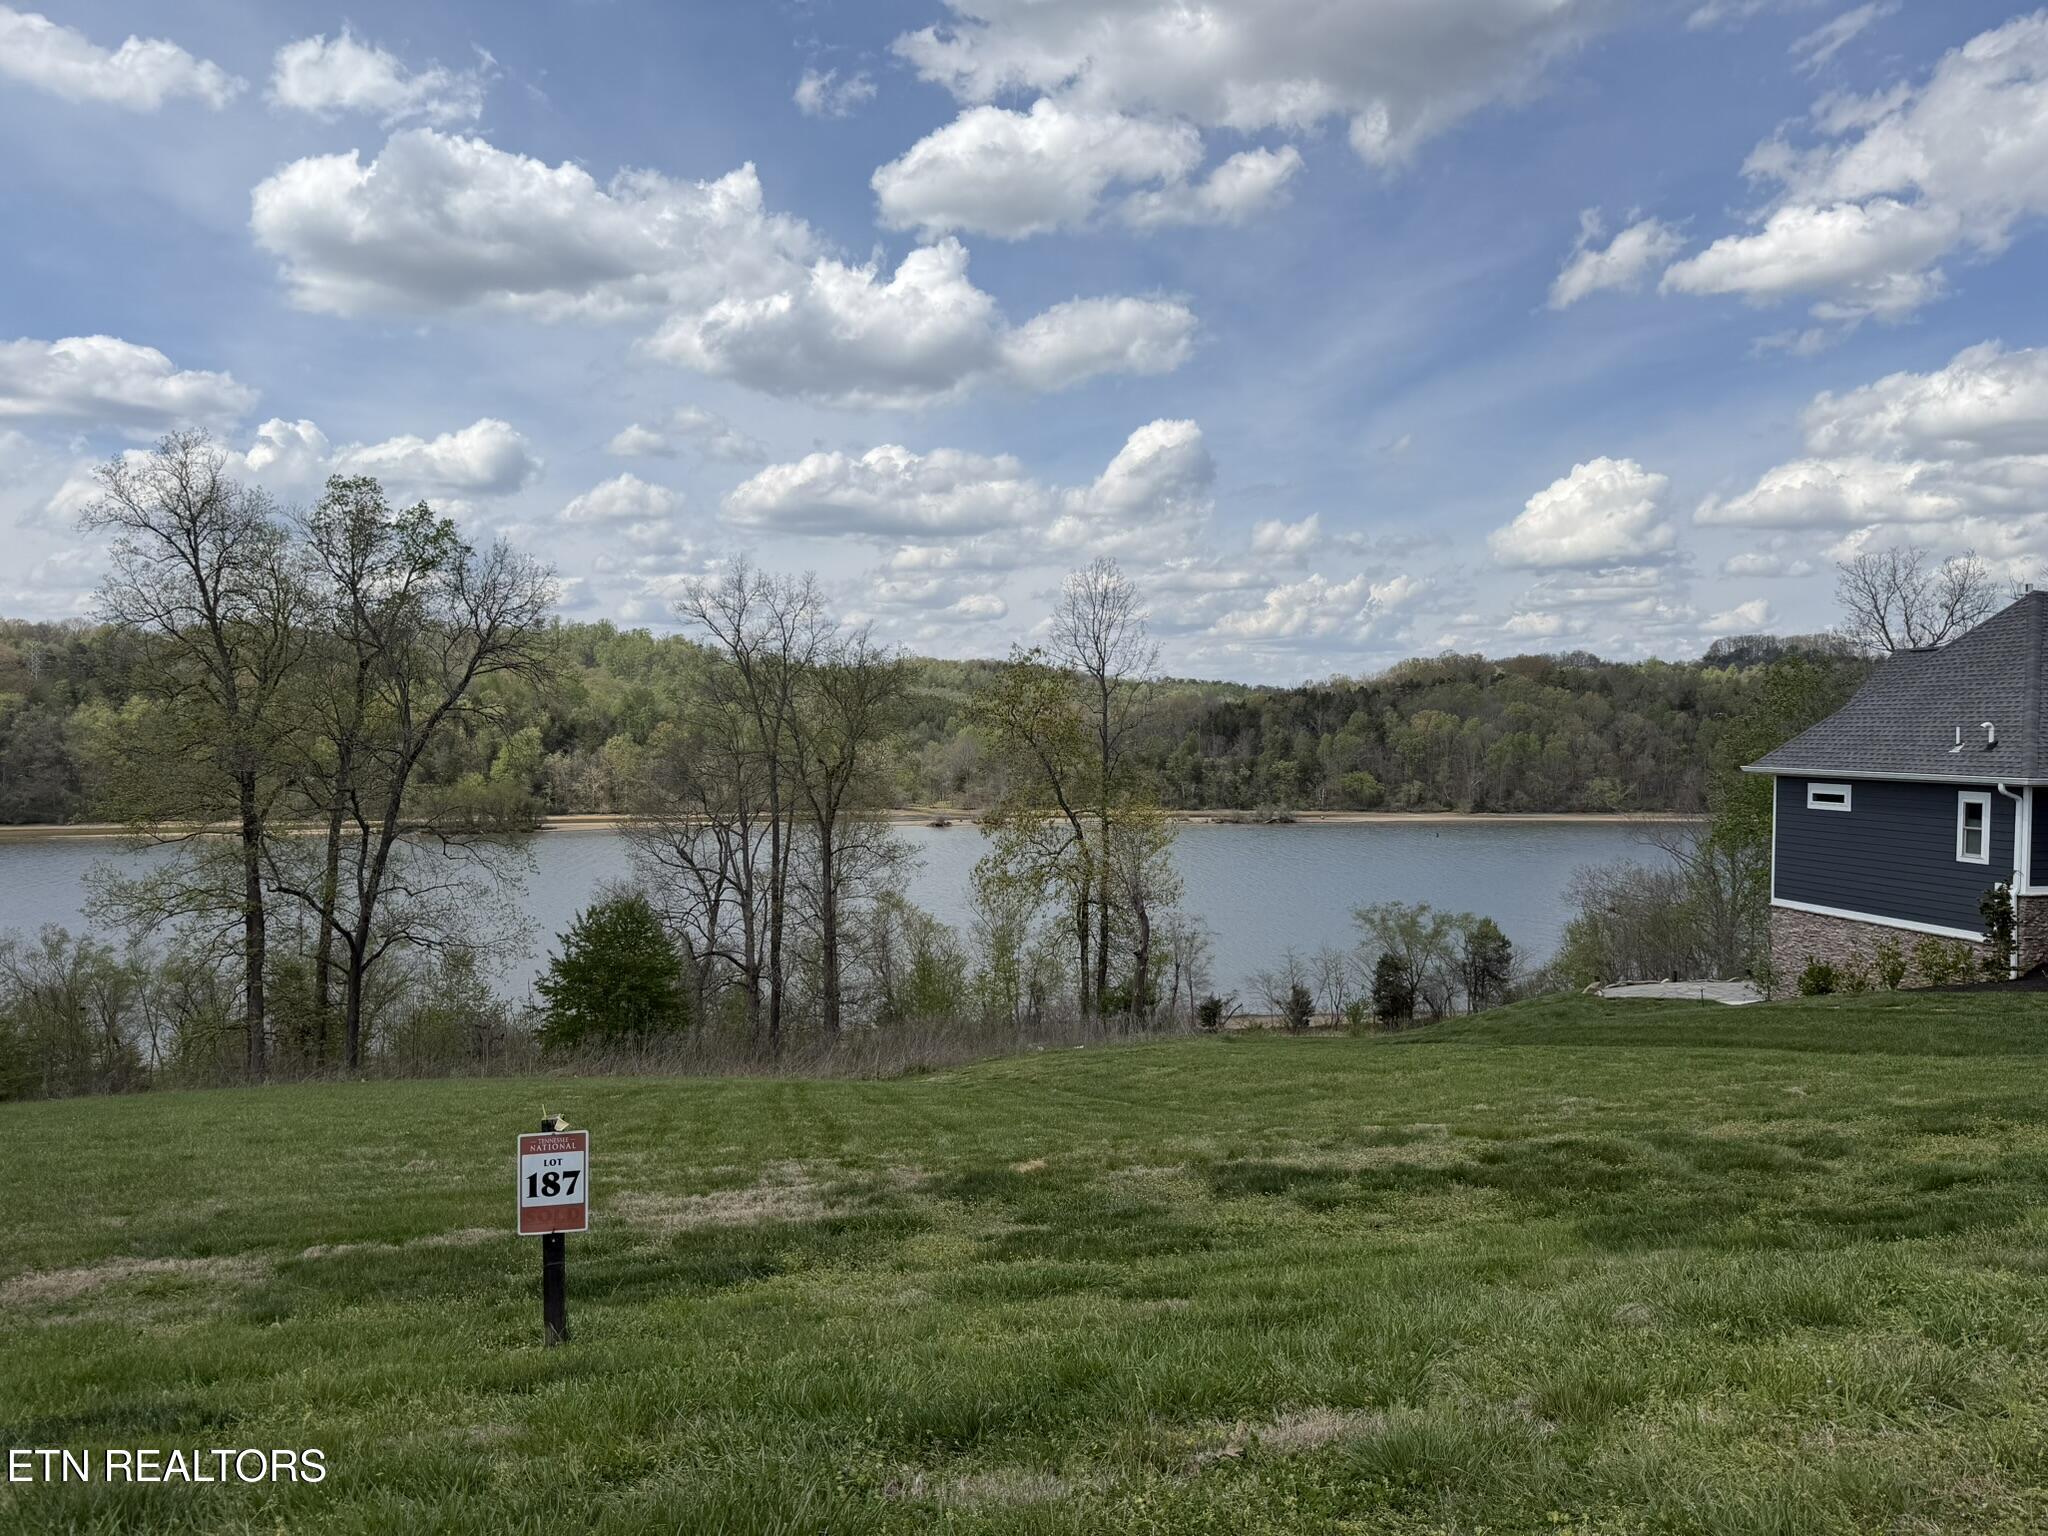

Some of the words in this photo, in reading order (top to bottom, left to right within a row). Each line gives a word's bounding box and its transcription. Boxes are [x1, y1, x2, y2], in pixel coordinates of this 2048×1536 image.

[529, 1142, 576, 1152] NATIONAL
[543, 1158, 563, 1167] LOT
[526, 1170, 581, 1198] 187
